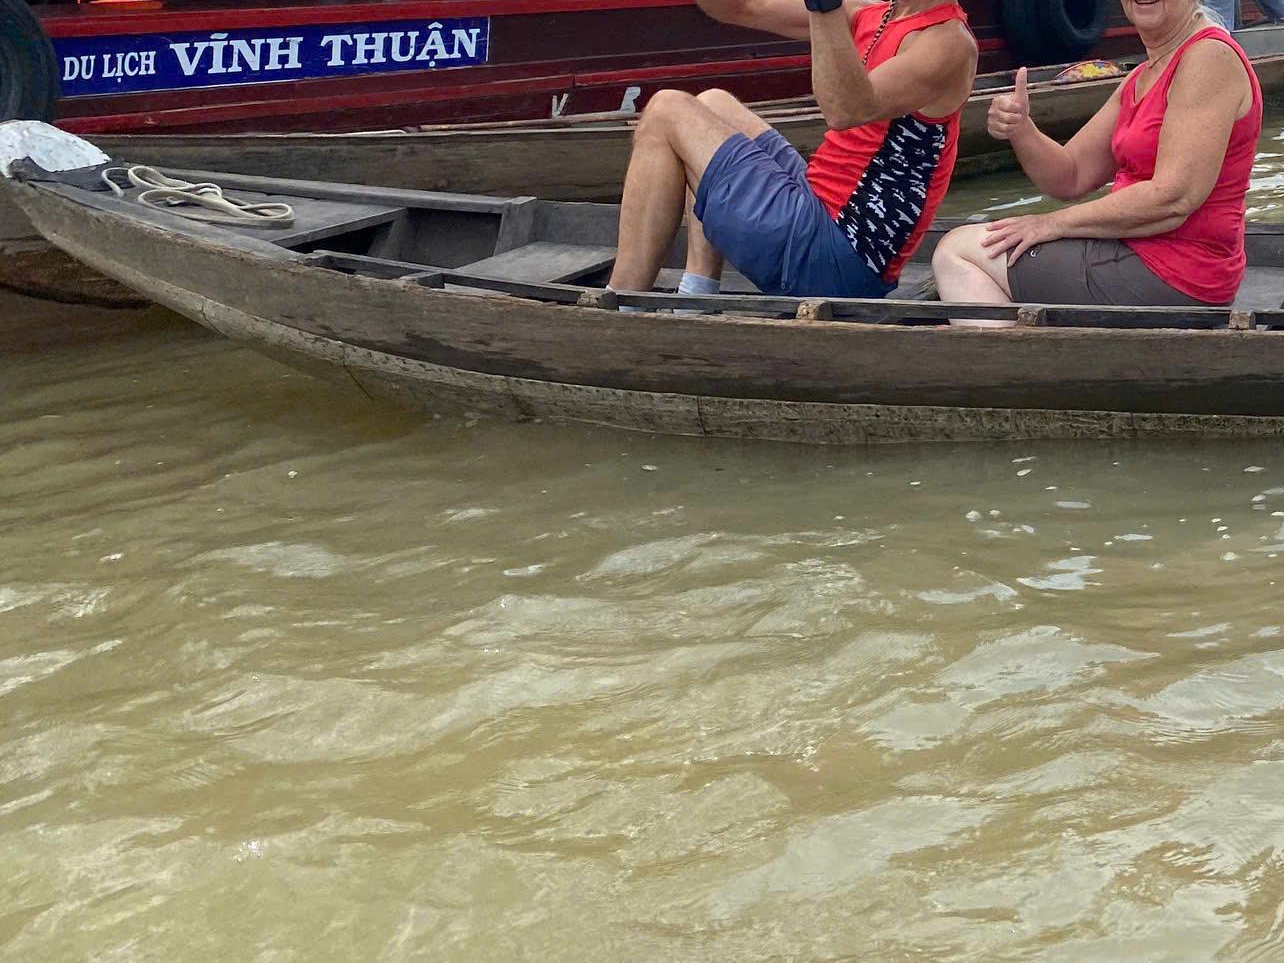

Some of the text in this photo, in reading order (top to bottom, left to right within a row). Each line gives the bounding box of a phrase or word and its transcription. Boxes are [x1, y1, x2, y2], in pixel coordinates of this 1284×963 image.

[63, 21, 481, 83] DU LỊCH VĨNH THUẬN
